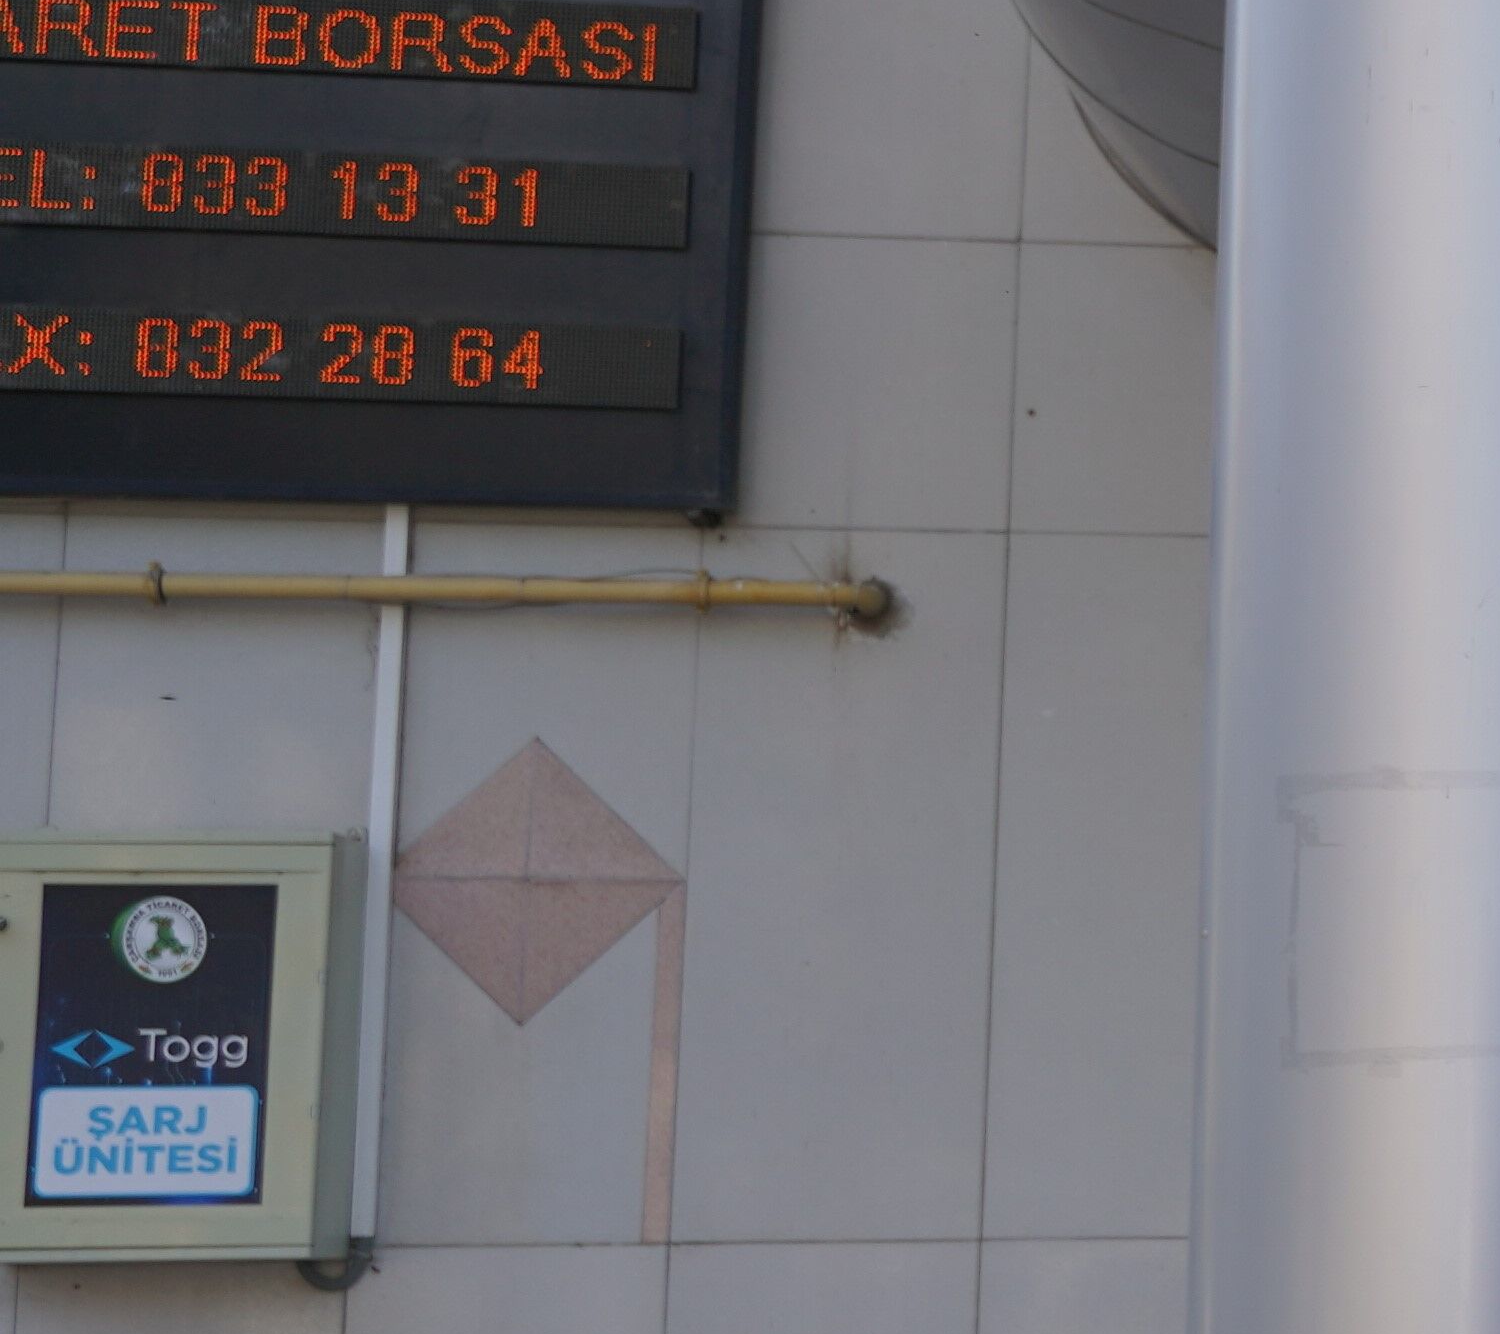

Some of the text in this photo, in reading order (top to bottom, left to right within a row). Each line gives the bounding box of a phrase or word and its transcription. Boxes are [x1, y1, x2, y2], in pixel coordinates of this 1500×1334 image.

[254, 4, 658, 83] BORSASI
[138, 152, 289, 217] 833
[330, 160, 420, 222] 13
[454, 166, 540, 228] 31
[134, 317, 285, 381] 832
[319, 323, 415, 385] 28
[450, 327, 544, 391] 64
[138, 1027, 250, 1068] Togg
[87, 1104, 208, 1141] ŞARJ
[53, 1136, 239, 1175] ÜNİTESİ
